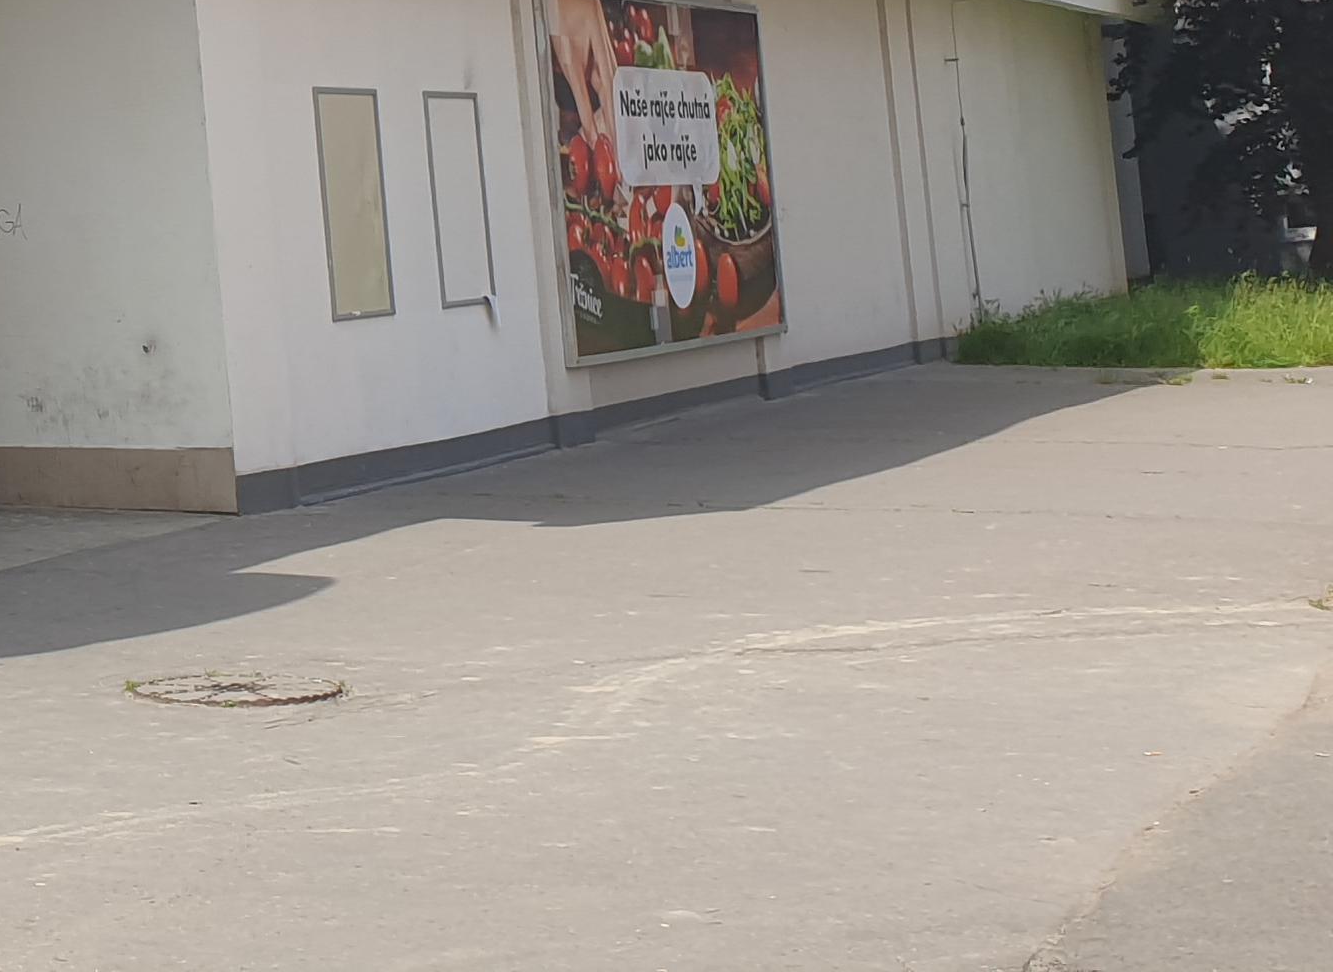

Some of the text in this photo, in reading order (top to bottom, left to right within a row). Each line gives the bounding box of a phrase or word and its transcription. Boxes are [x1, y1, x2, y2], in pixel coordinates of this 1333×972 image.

[620, 89, 711, 126] Naše rajče chutná
[643, 134, 697, 170] jako rajče
[667, 244, 694, 269] albert
